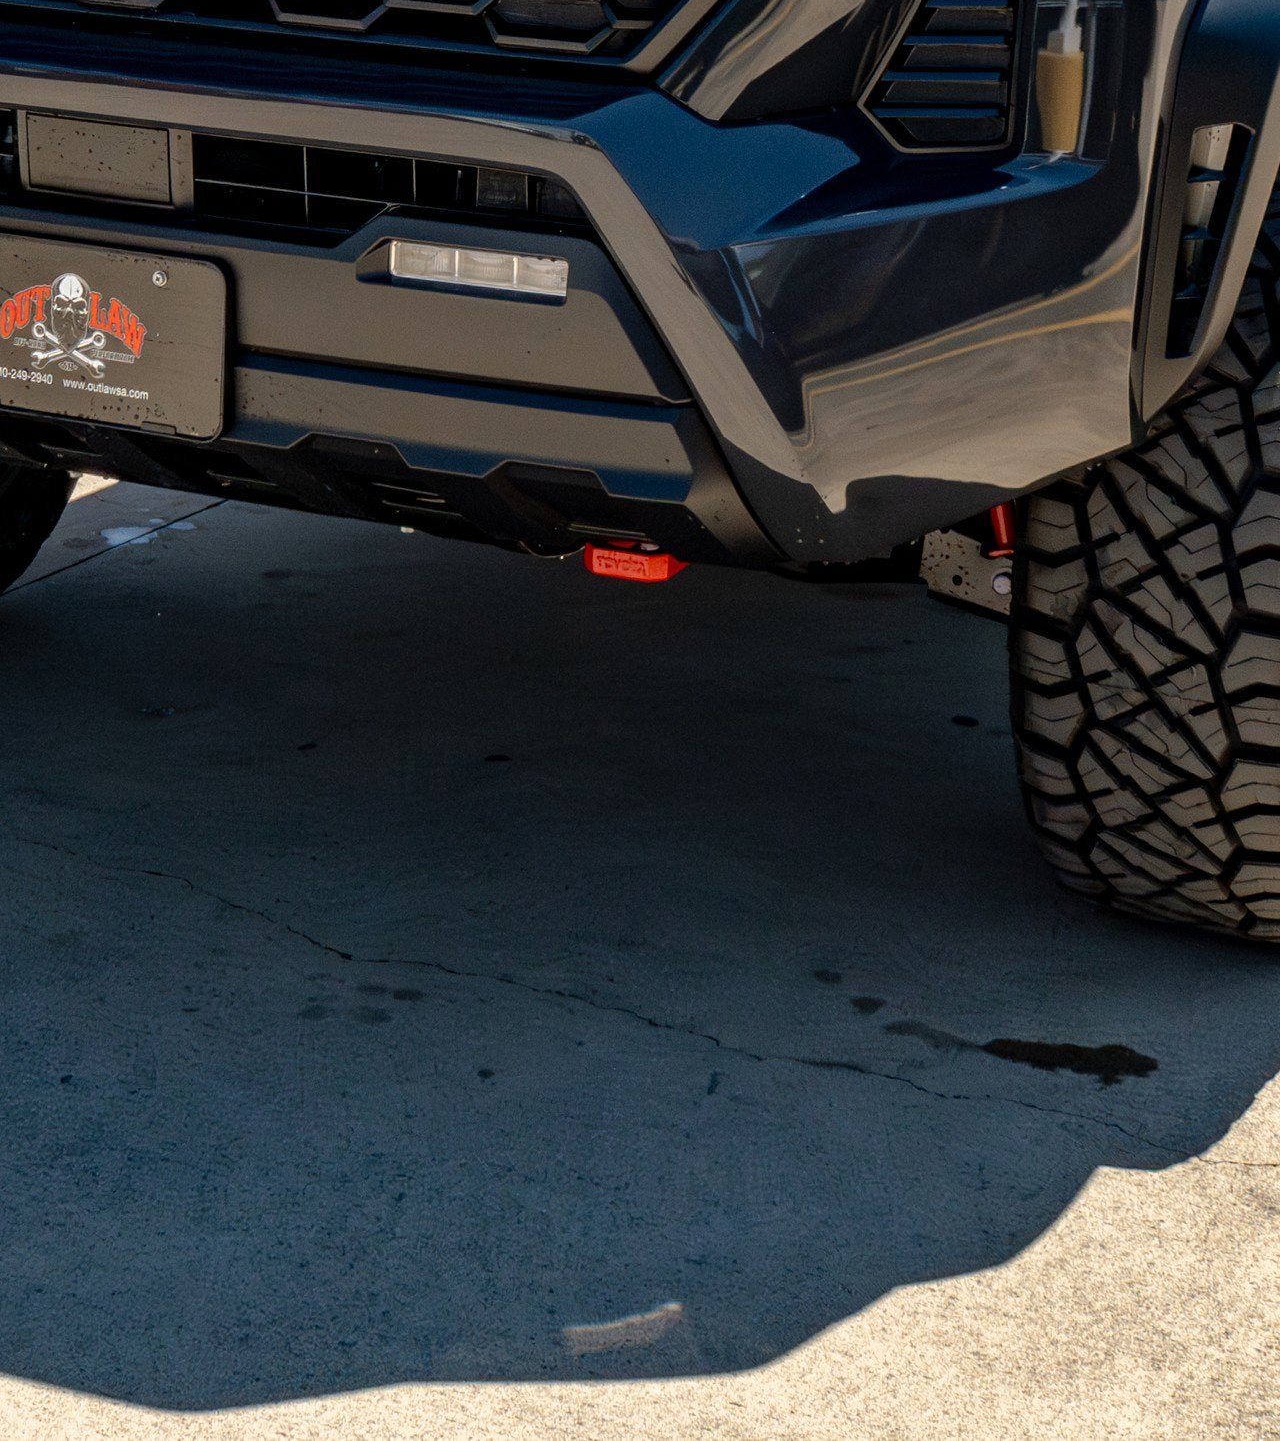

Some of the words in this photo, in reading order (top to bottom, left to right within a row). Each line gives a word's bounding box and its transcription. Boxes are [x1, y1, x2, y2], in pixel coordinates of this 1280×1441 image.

[0, 285, 52, 339] OUT
[88, 291, 148, 358] LAW
[62, 379, 149, 400] www.outlawsa.com
